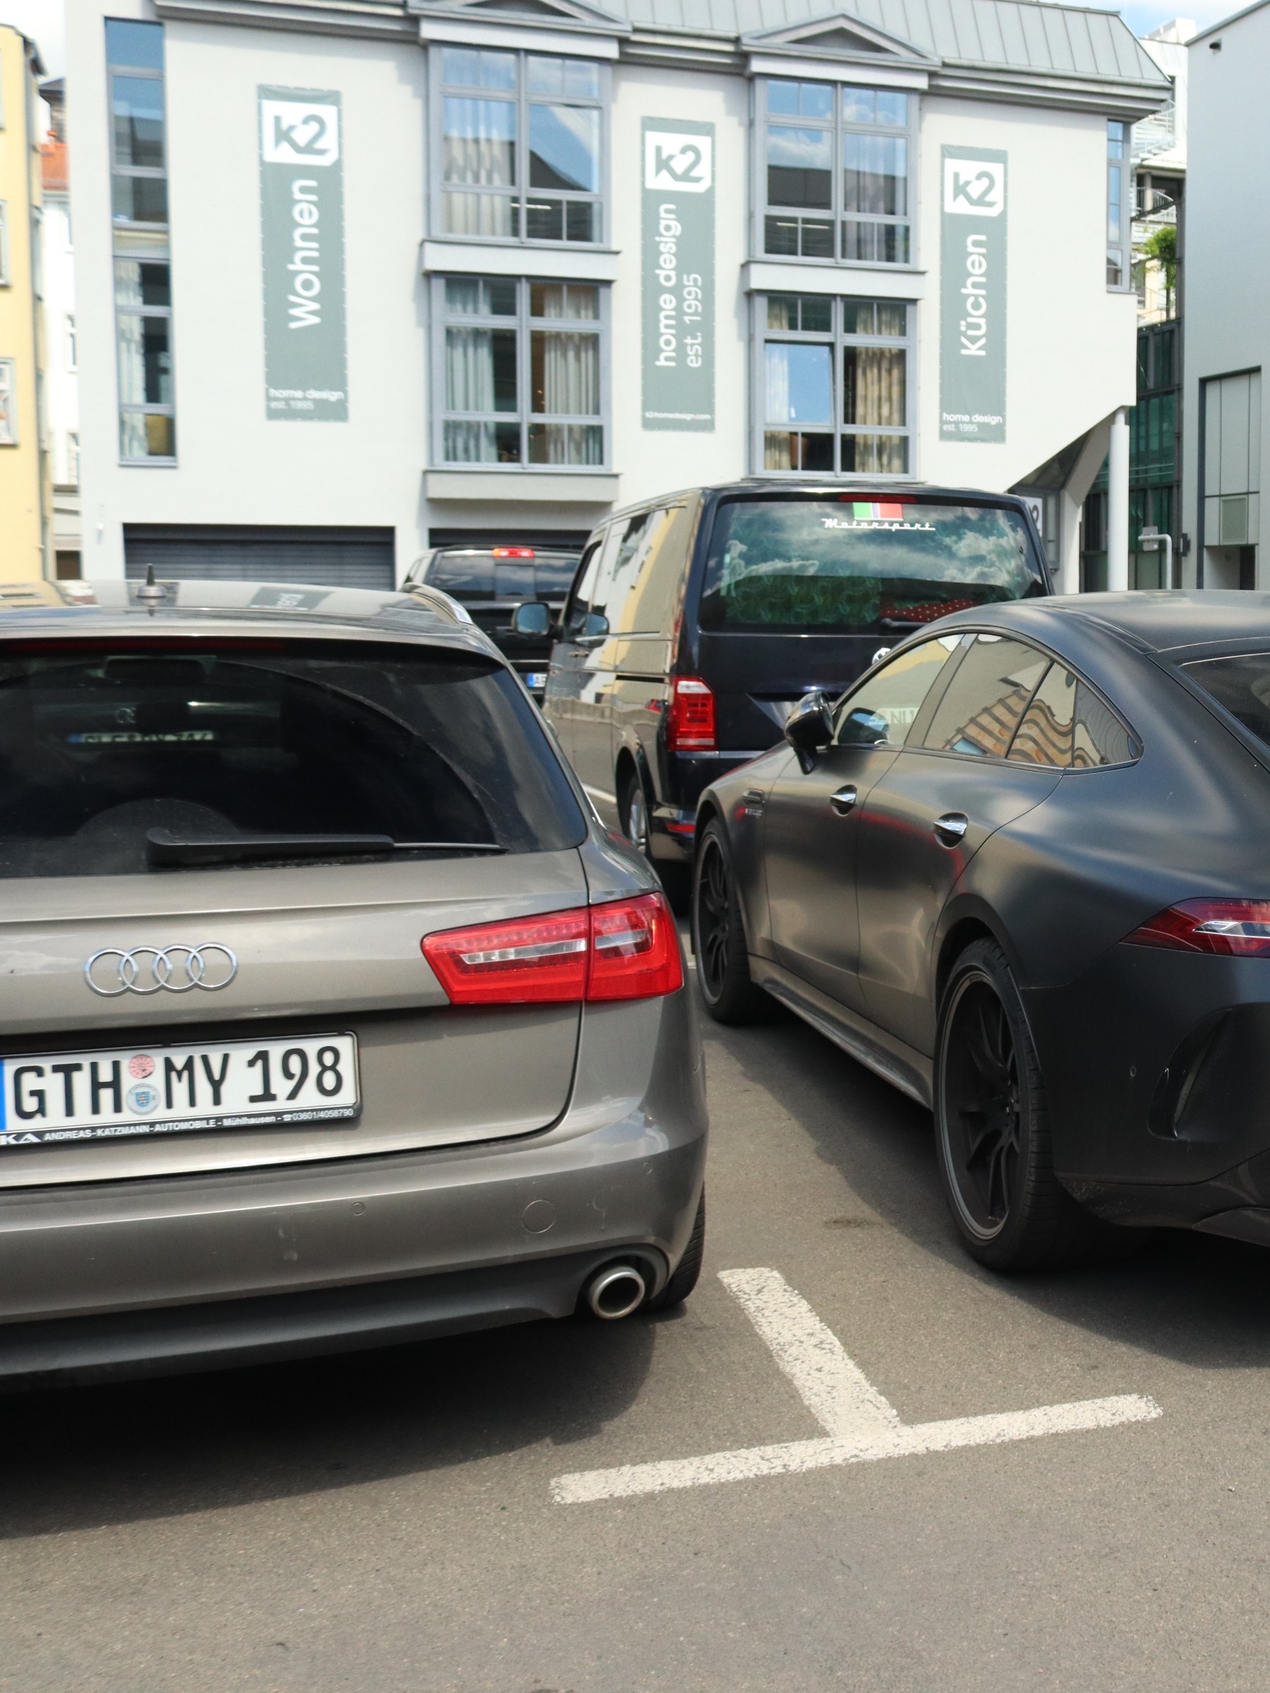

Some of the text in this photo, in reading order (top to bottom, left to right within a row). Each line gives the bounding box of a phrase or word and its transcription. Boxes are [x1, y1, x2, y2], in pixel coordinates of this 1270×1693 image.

[287, 179, 321, 329] Wohnen
[655, 204, 682, 367] home design
[960, 234, 987, 356] Küchen
[683, 273, 702, 367] est. 1995
[269, 387, 344, 402] home design
[943, 412, 1003, 425] home design
[959, 424, 978, 432] 1995
[821, 518, 936, 532] Motorsport
[13, 1045, 344, 1119] GTH MY 198
[223, 1115, 276, 1127] Mühlhausen
